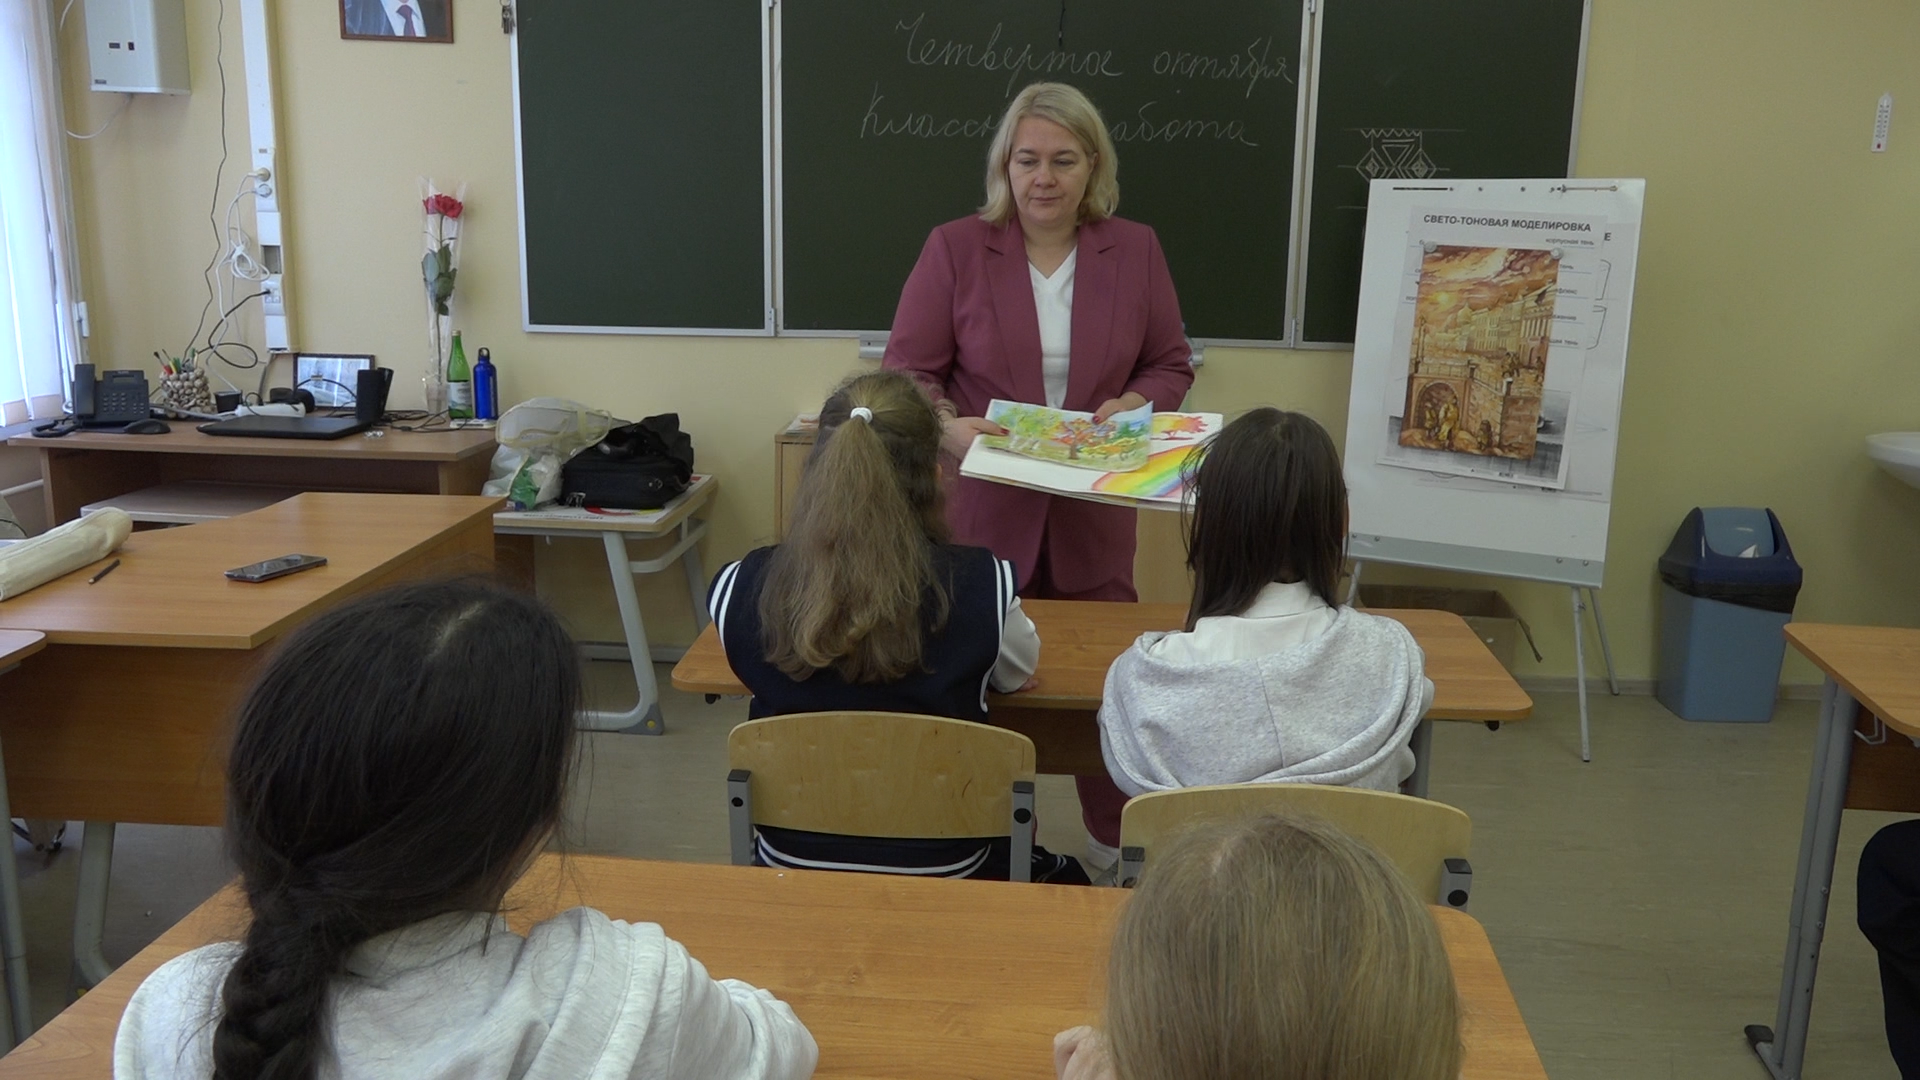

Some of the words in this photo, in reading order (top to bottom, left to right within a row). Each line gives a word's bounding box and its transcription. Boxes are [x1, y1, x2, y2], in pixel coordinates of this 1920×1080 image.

[895, 12, 1123, 98] Четвертое
[1153, 36, 1294, 98] октября
[860, 80, 1001, 138] Классн
[1109, 101, 1259, 146] абота
[1423, 214, 1509, 228] СВЕТО-ТОНОВАЯ
[1511, 219, 1591, 232] МОДЕЛИРОВКА
